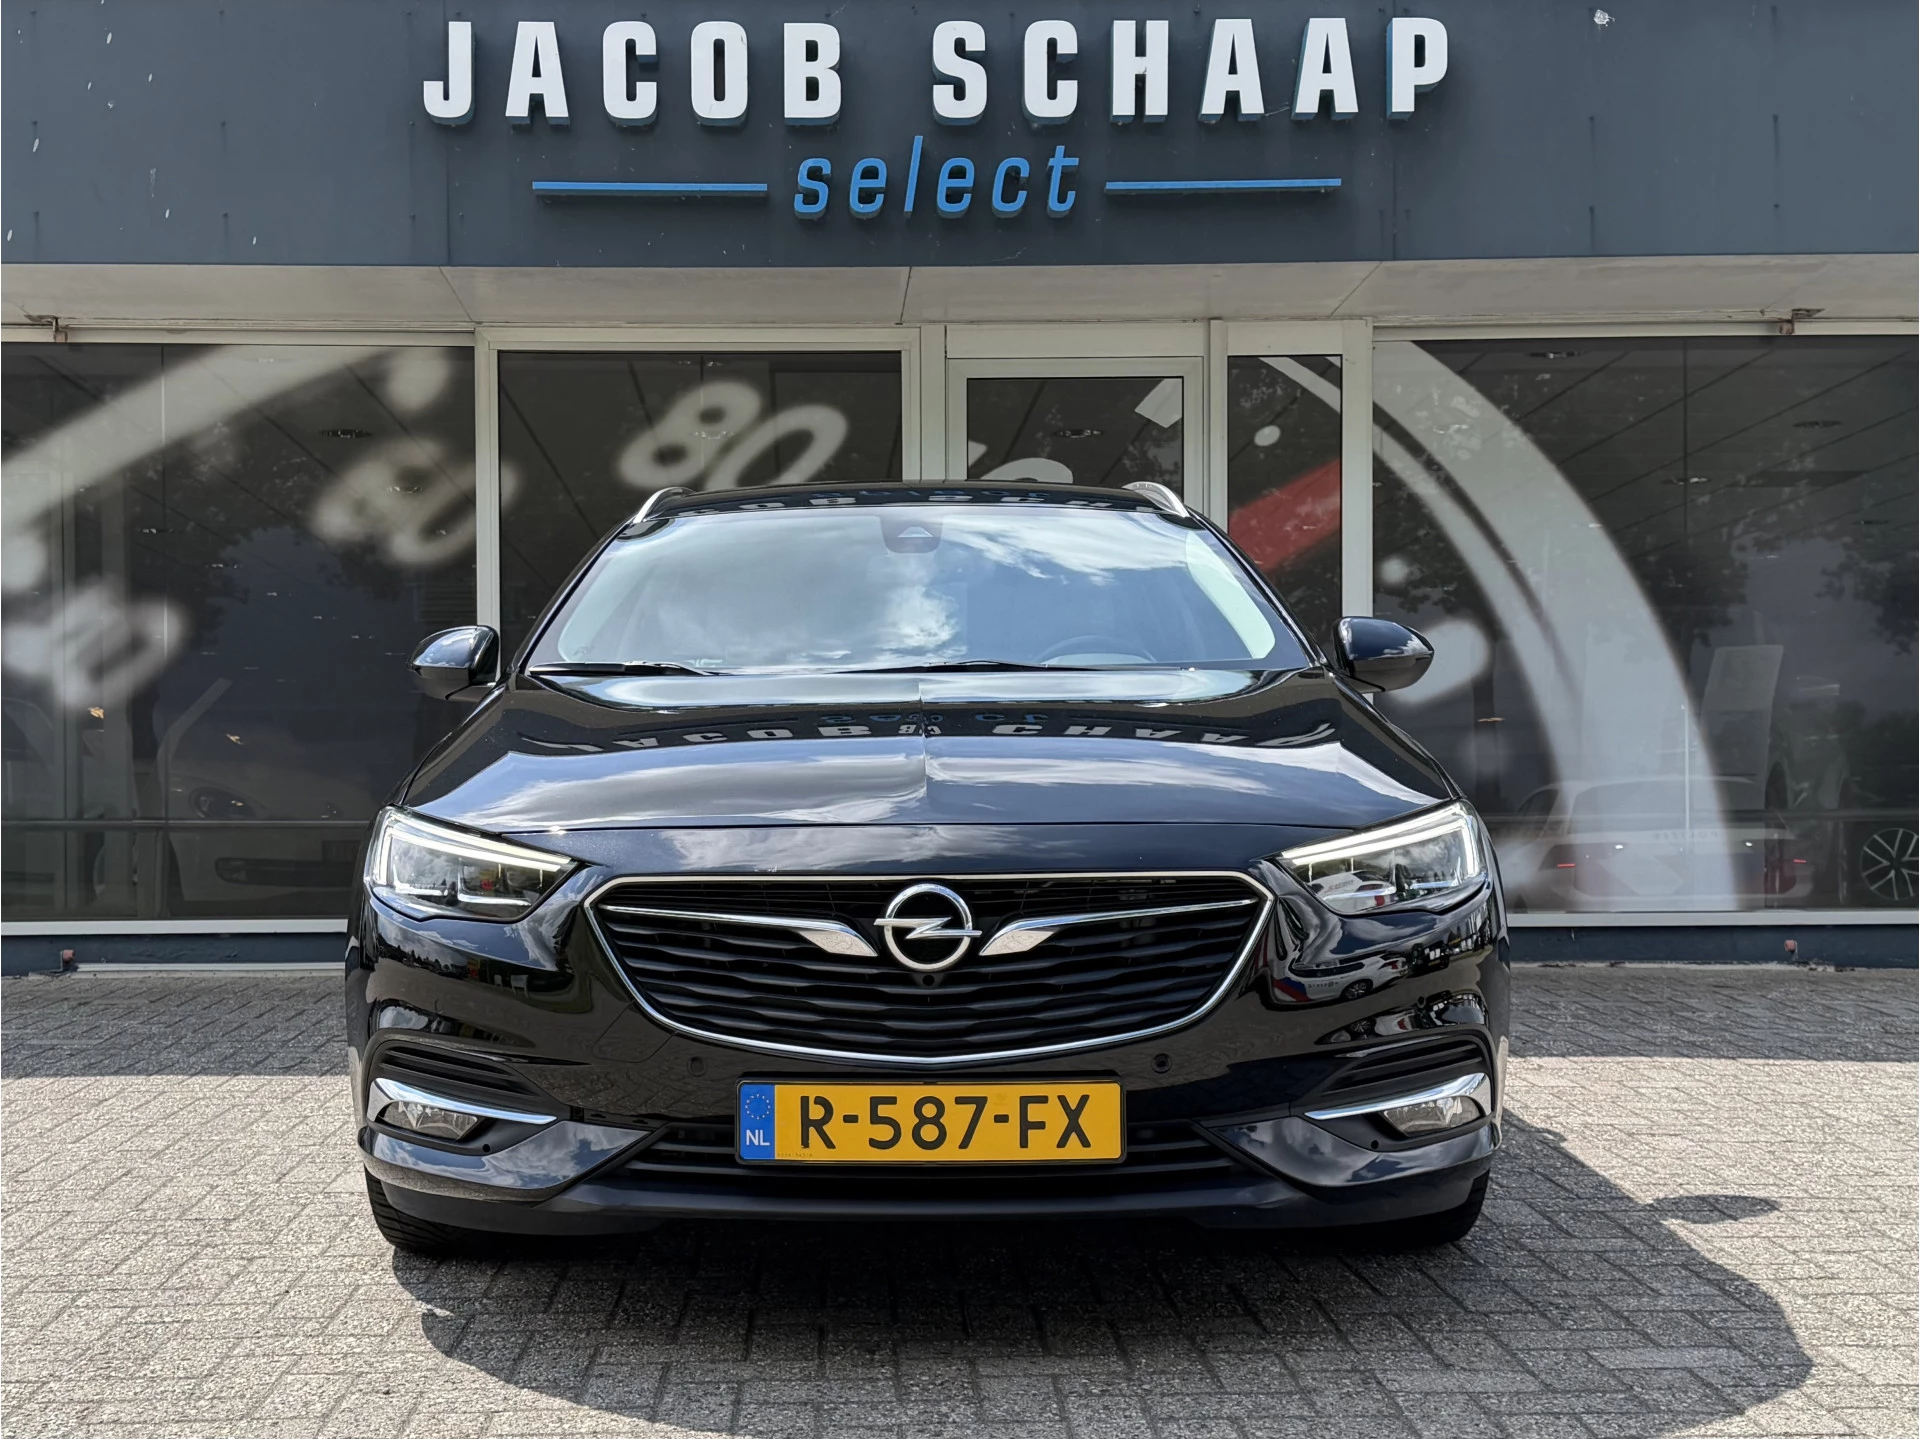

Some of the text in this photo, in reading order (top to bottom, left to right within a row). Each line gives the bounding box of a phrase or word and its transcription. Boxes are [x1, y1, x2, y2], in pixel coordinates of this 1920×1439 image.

[423, 17, 1449, 122] JACOB SCHAAP
[794, 135, 1079, 216] select
[745, 1128, 771, 1147] NL
[800, 1094, 1092, 1150] R-587-FX
